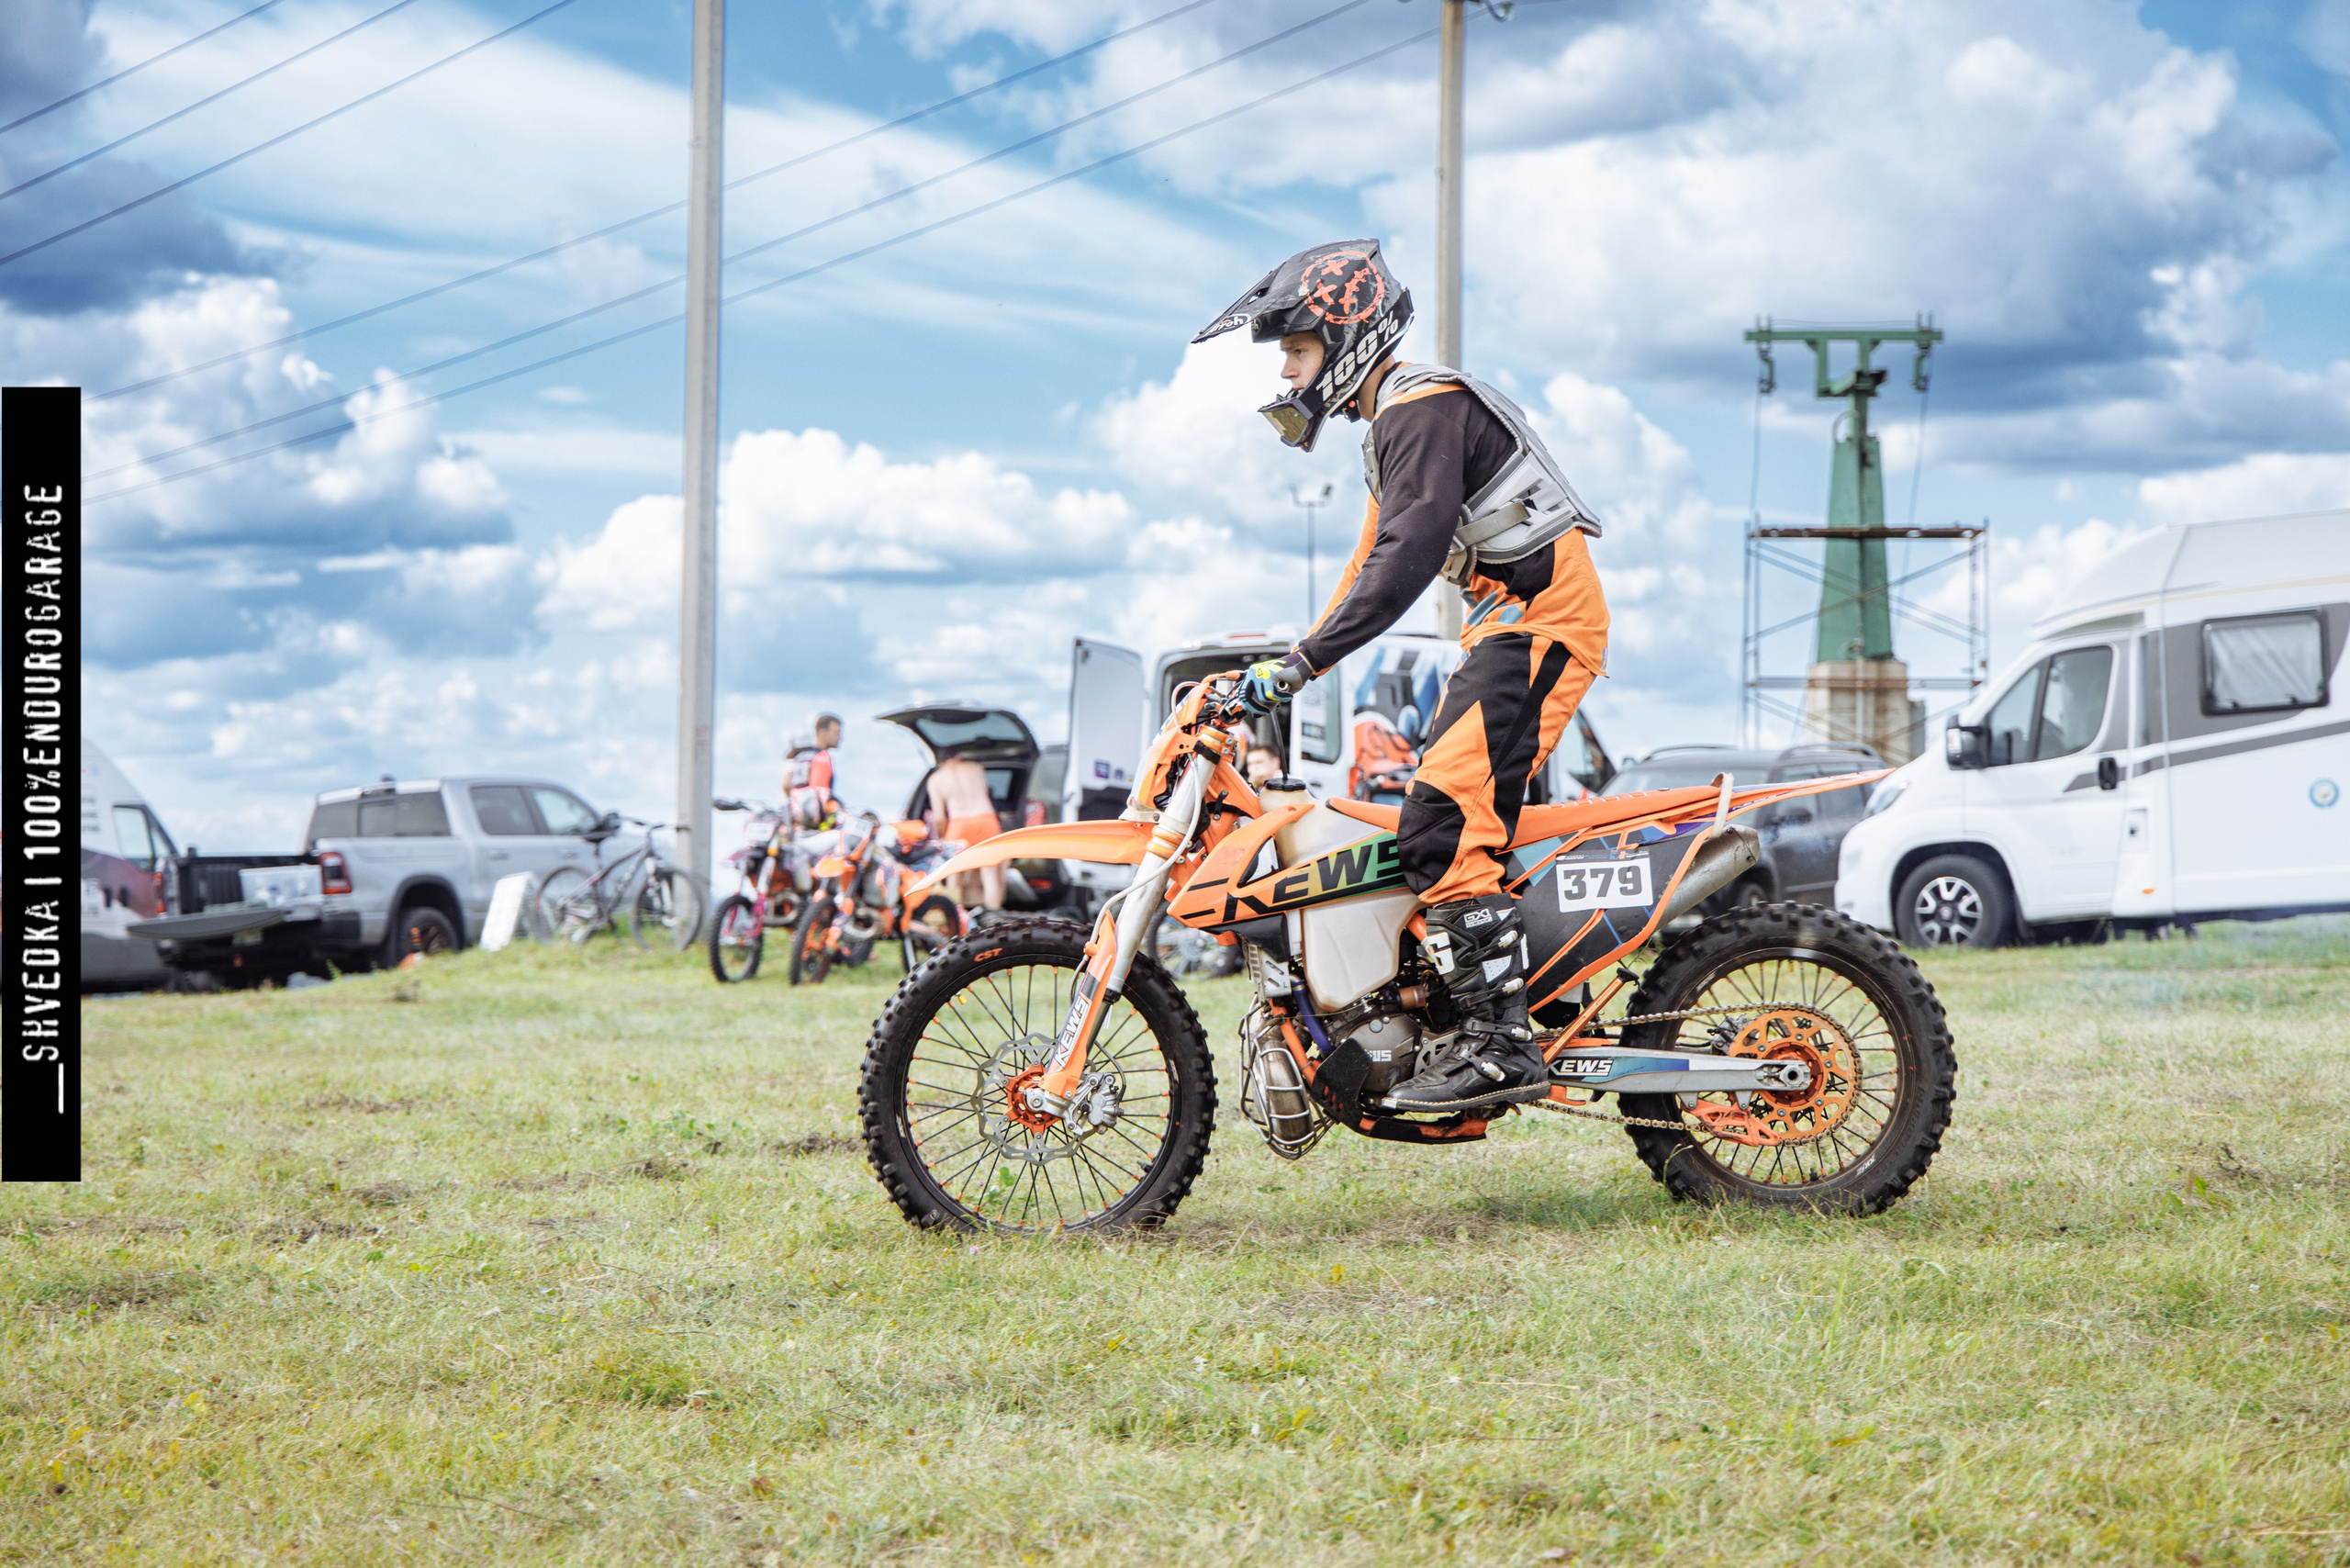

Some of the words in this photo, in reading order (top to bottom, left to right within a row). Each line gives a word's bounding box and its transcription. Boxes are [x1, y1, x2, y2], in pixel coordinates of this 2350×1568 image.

[1315, 310, 1398, 401] 100%
[1563, 865, 1642, 902] 379
[974, 947, 1003, 962] CST
[1055, 995, 1089, 1068] KEWS
